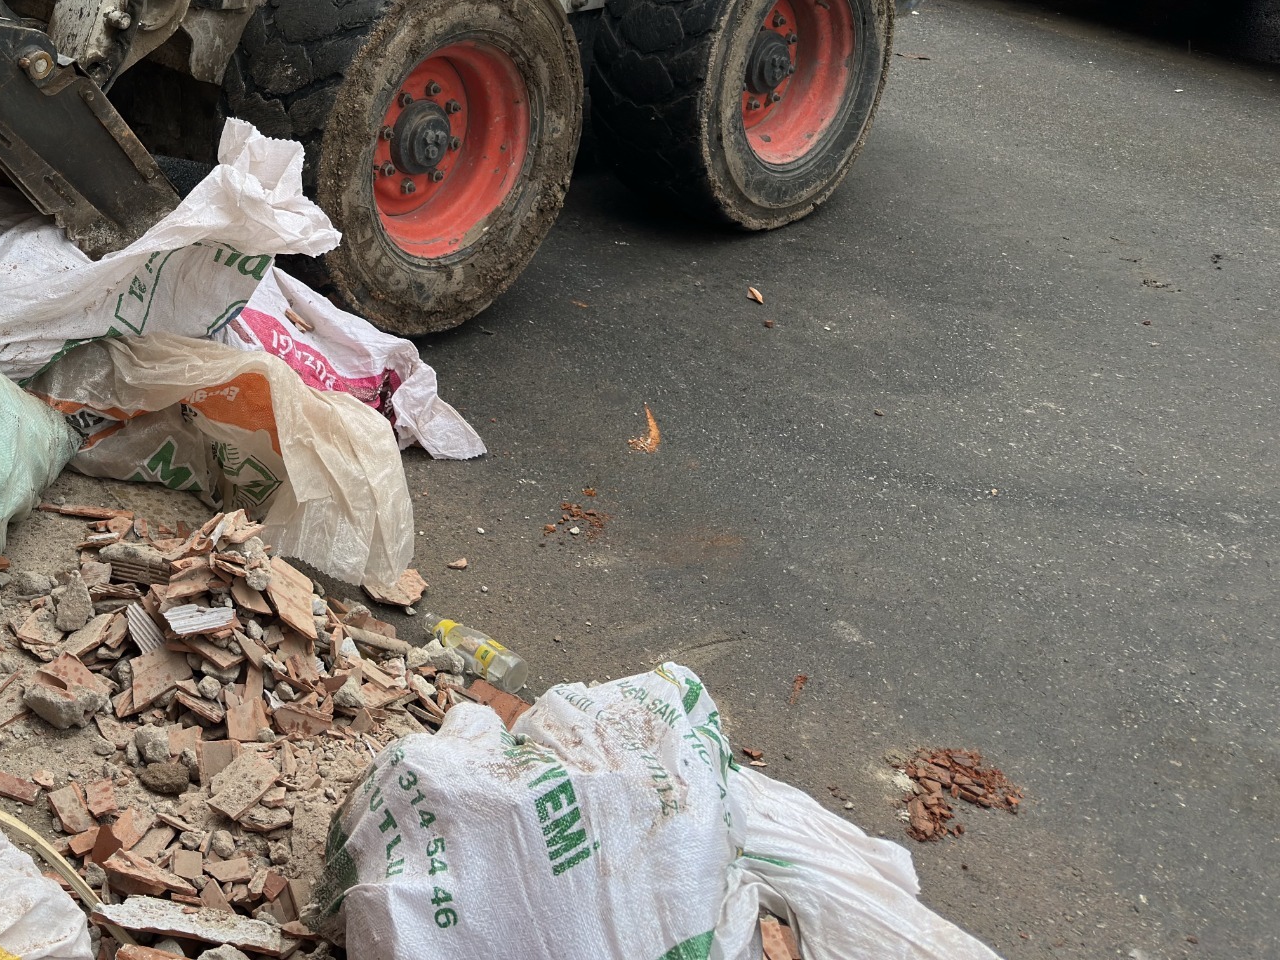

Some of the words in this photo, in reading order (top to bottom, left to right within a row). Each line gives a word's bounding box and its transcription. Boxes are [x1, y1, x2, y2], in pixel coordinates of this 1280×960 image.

[398, 770, 436, 829] 314
[527, 763, 601, 877] YEMİ
[426, 837, 449, 877] 54
[431, 885, 459, 929] 46
